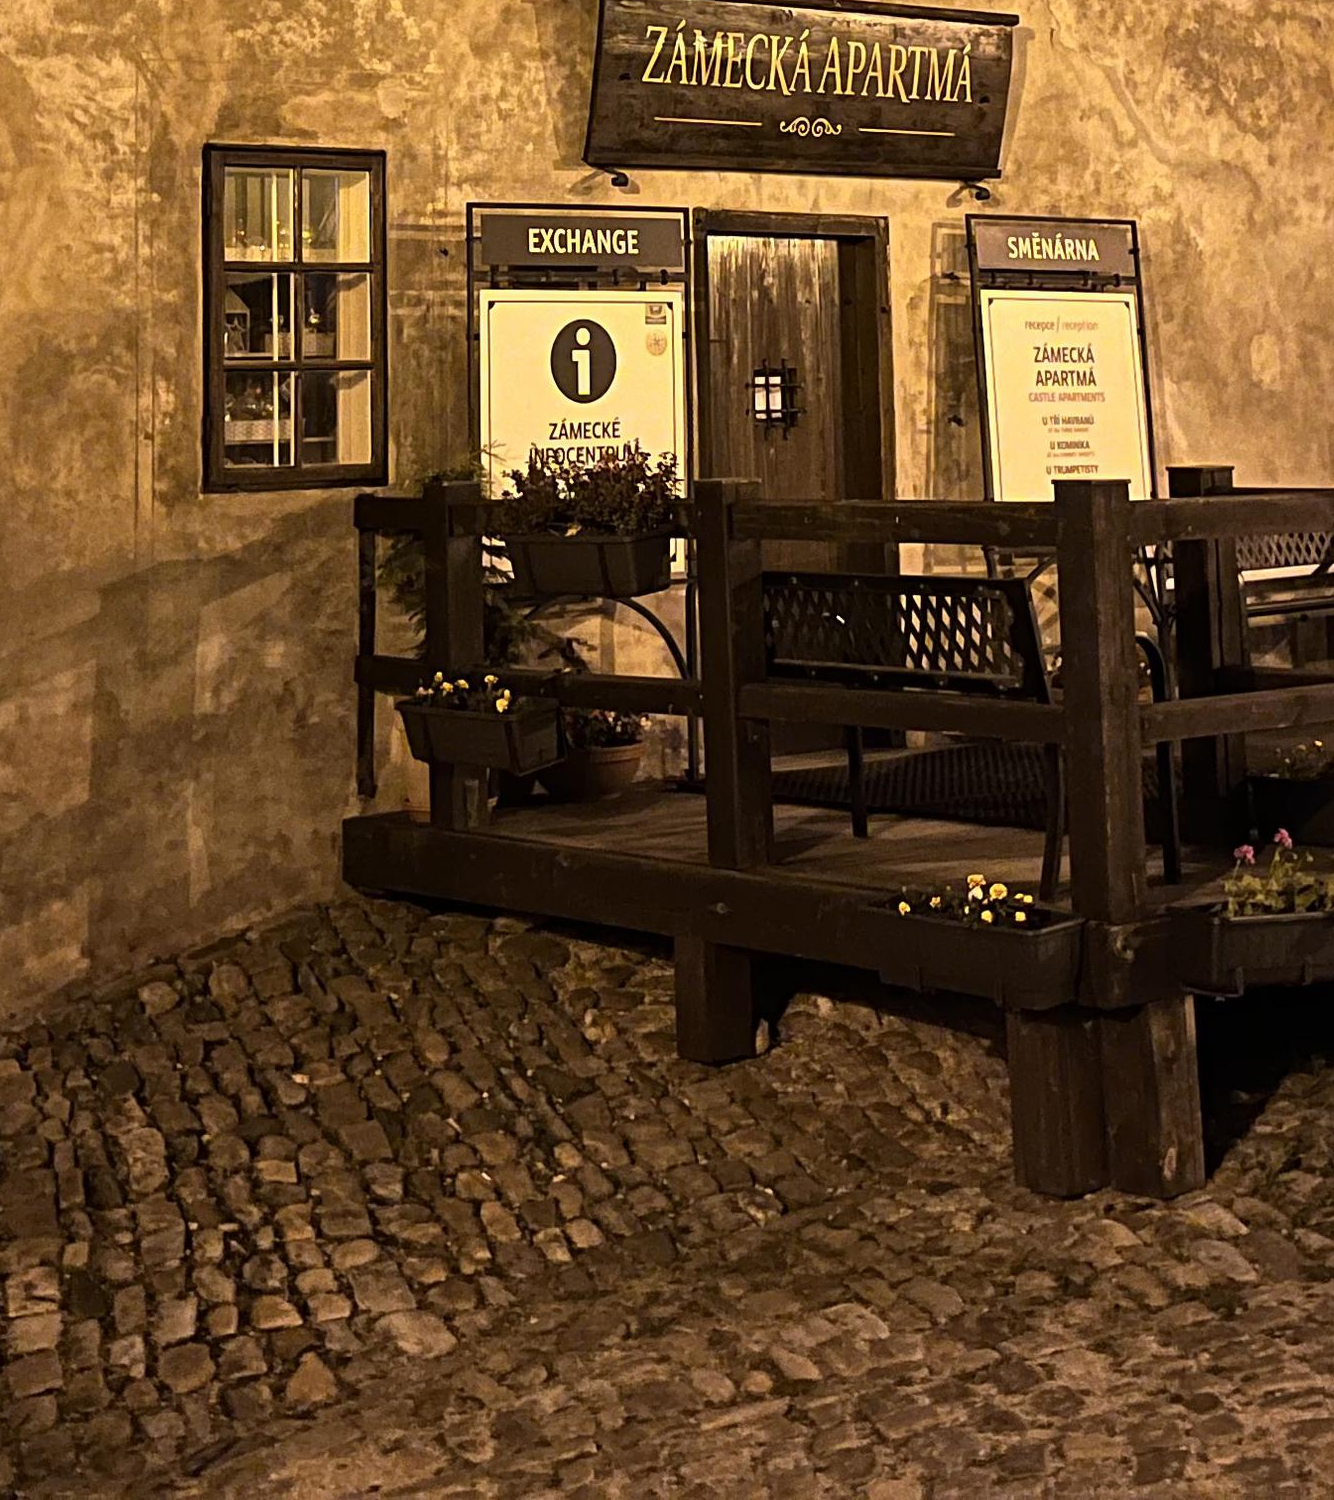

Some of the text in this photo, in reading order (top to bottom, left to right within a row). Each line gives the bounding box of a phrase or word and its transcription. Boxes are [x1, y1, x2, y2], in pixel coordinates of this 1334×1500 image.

[642, 19, 973, 103] ZÁMECKÁ APARTMÁ
[528, 228, 639, 255] EXCHANGE
[1007, 232, 1100, 261] SMĚNÁRNA
[1024, 320, 1055, 332] recepce
[1062, 320, 1099, 332] reception
[1033, 343, 1095, 364] ZÁMECKÁ
[1035, 367, 1097, 387] APARTMÁ
[1028, 392, 1106, 403] CASTLE APARTMENTS
[548, 417, 621, 440] ZÁMECKÉ
